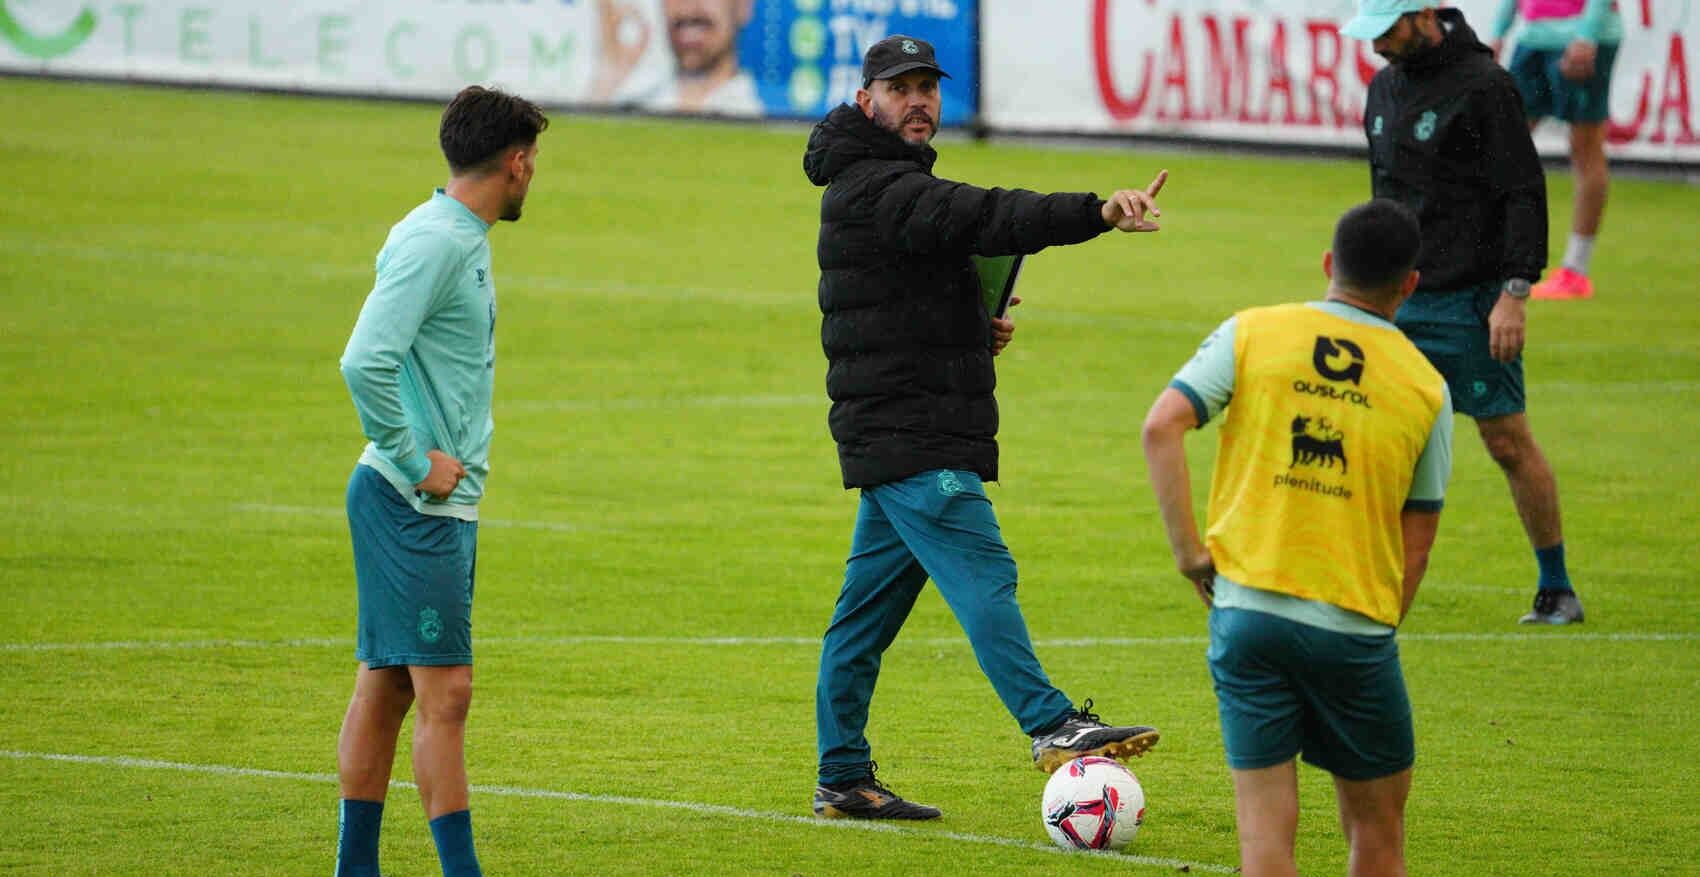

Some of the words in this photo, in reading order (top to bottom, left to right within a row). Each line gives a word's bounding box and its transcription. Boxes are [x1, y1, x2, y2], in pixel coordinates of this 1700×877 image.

[110, 5, 577, 82] TELECOM
[1293, 379, 1372, 408] austral
[1273, 471, 1353, 499] plenitude
